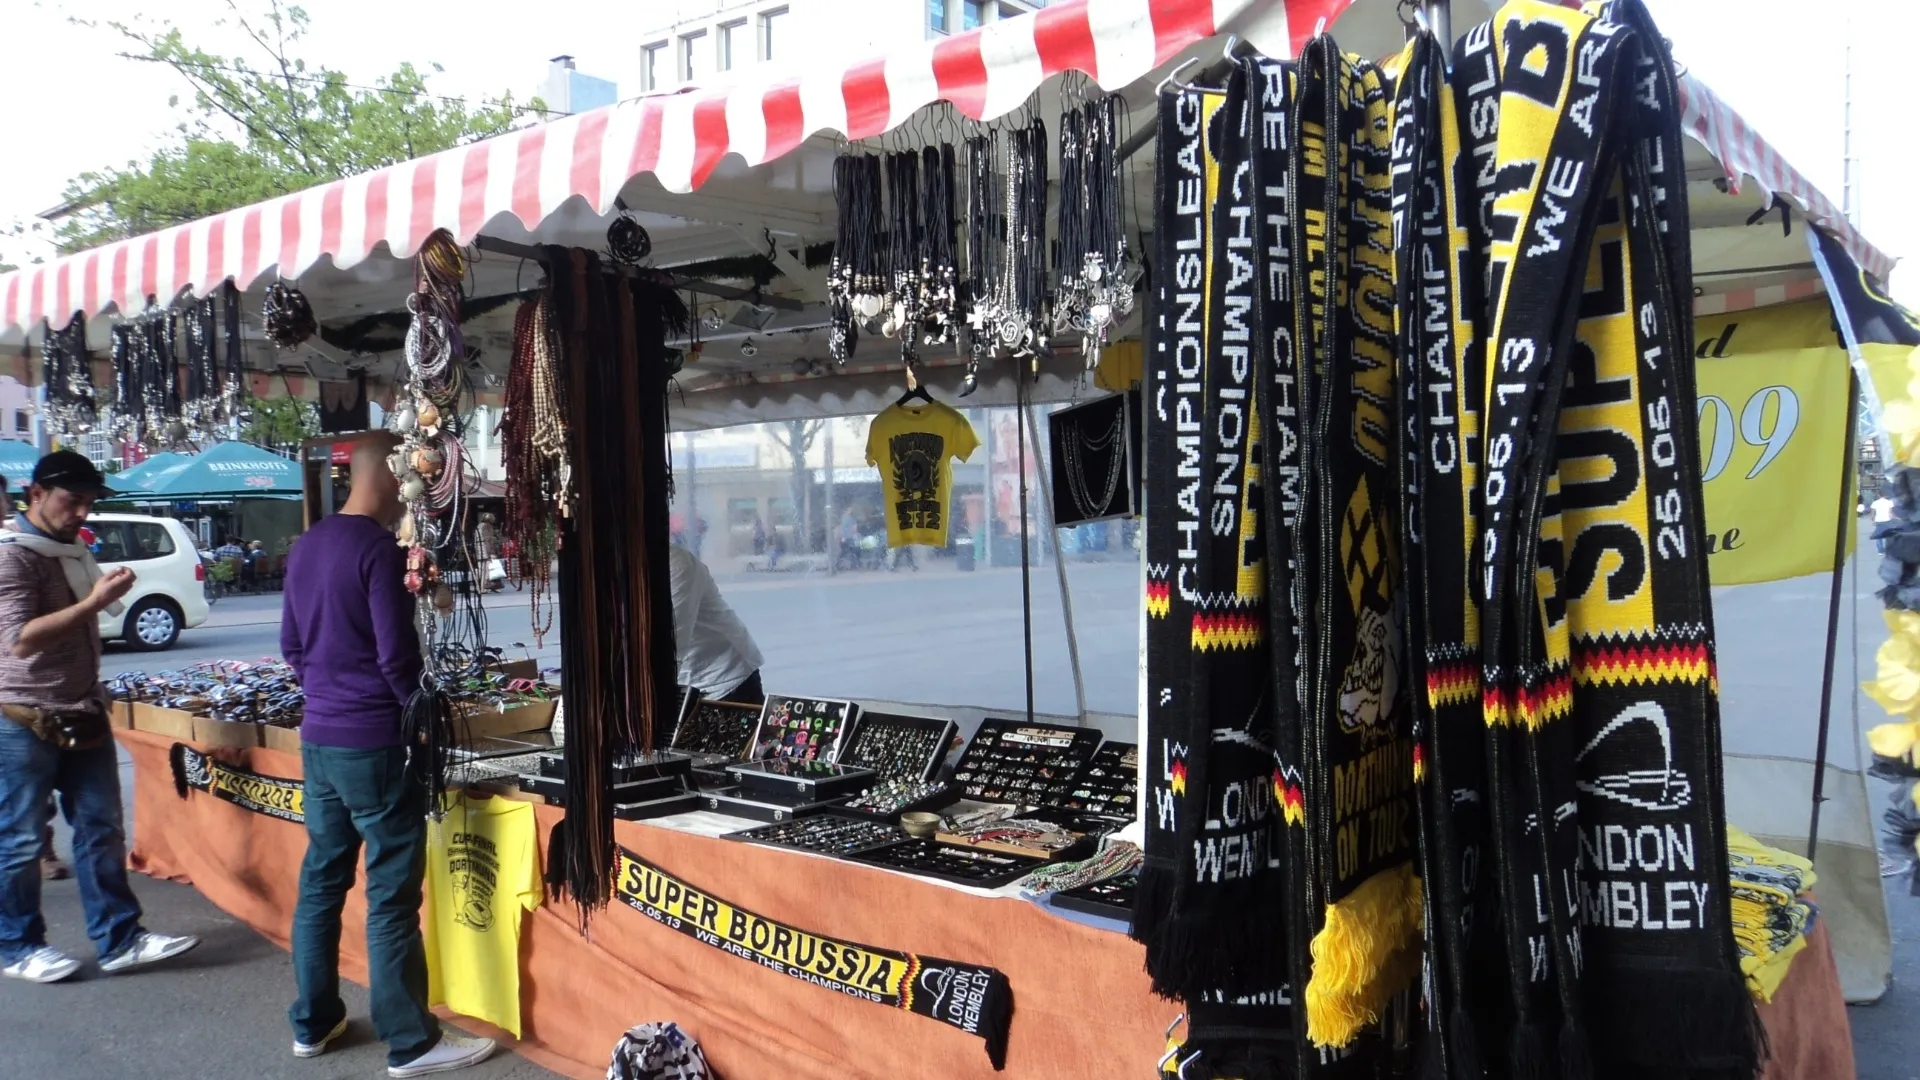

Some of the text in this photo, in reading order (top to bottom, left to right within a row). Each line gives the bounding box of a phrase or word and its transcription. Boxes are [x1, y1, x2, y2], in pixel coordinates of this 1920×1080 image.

[1264, 177, 1291, 302] THE
[1526, 155, 1584, 258] WE
[1640, 301, 1687, 560] 25.05.13
[1337, 818, 1360, 882] ON
[625, 863, 893, 993] SUPER BORUSSIA
[629, 897, 883, 1004] 25.05.13 WE ARE THE CHAMPIONS
[947, 970, 973, 1026] LONDON
[961, 971, 992, 1036] WEMBLEY
